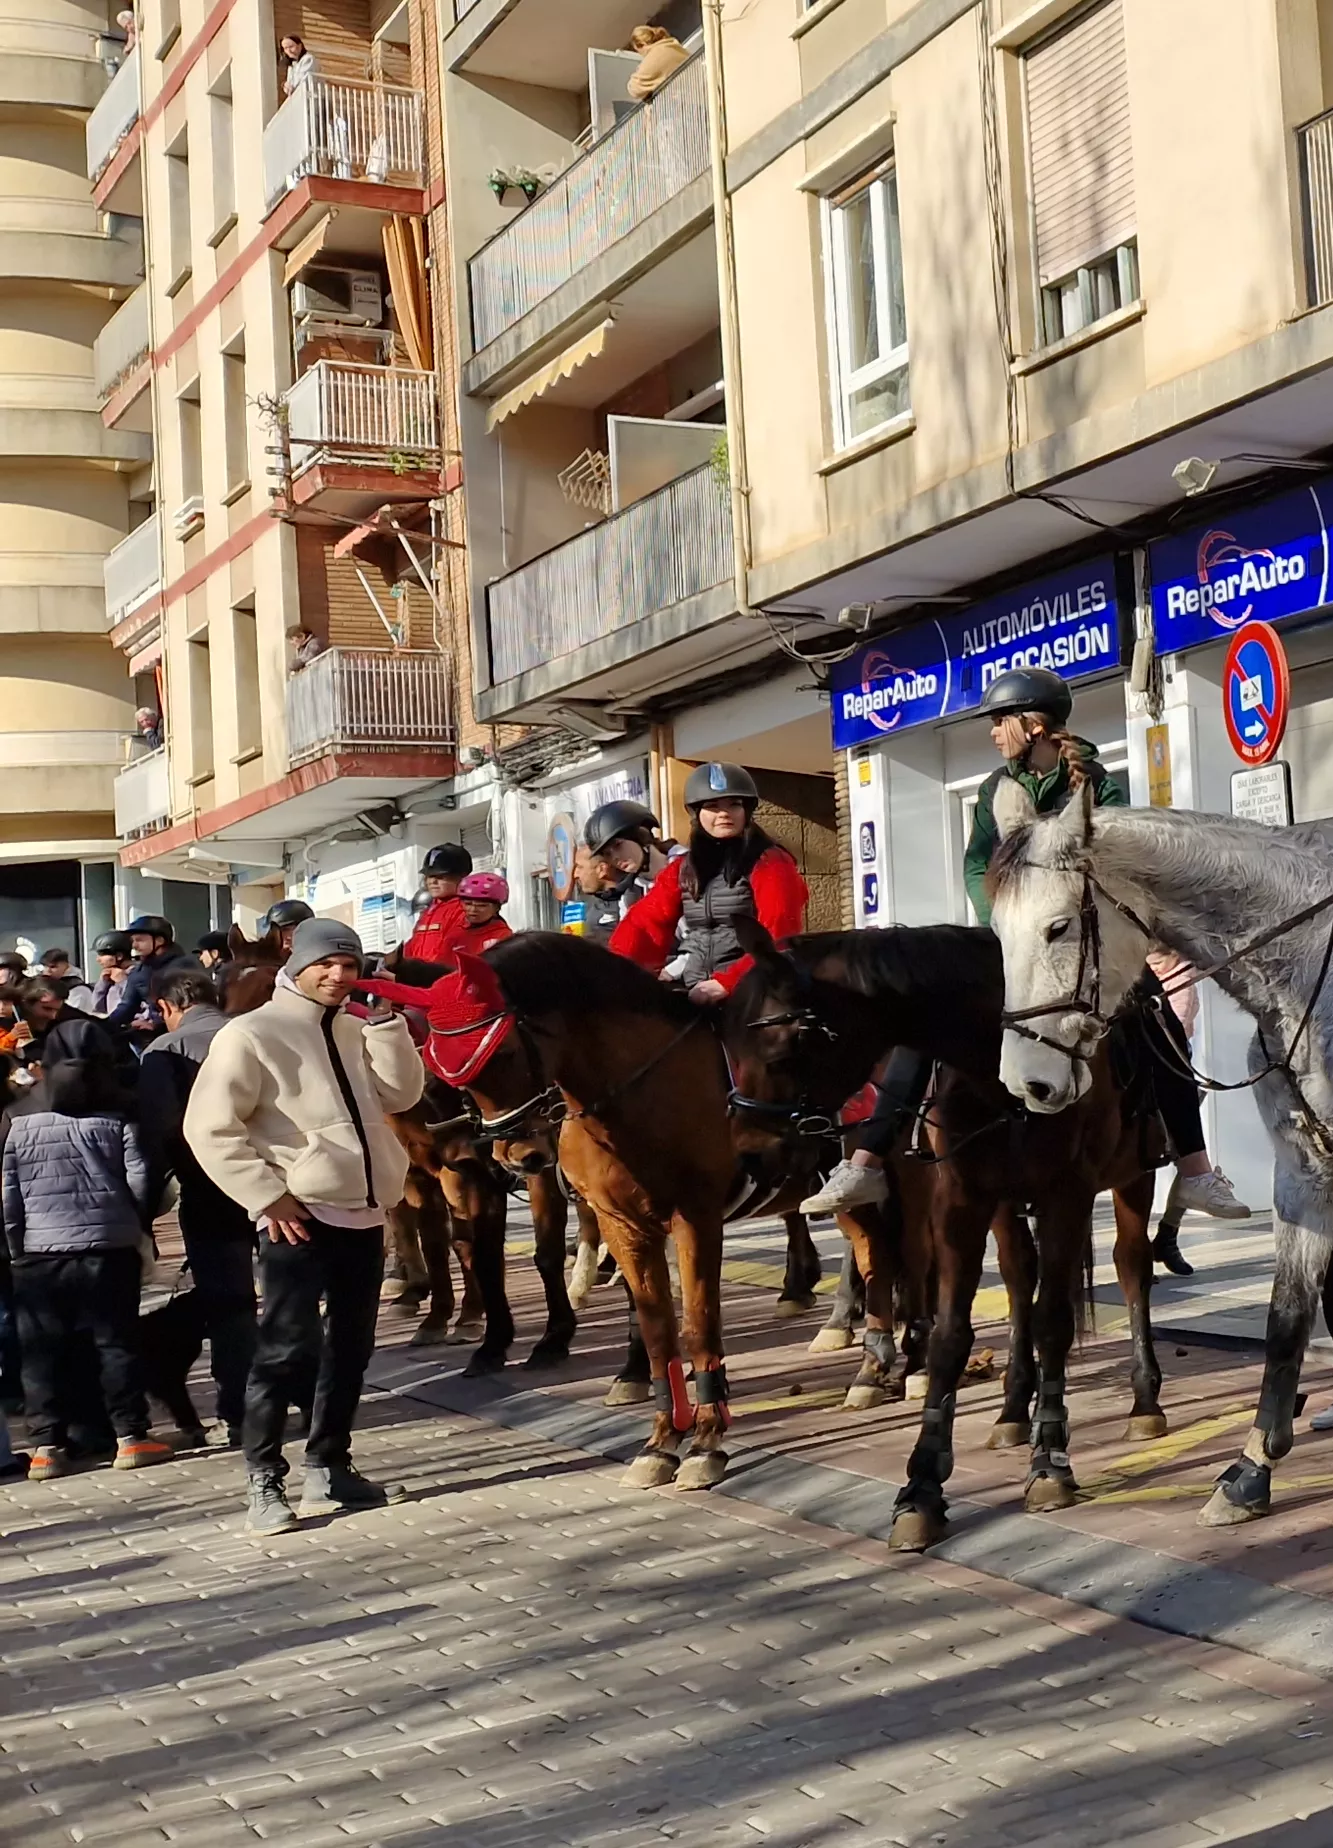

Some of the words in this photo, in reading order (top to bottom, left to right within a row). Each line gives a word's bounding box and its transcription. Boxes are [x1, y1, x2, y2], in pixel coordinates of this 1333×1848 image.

[1167, 552, 1305, 619] ReparAuto
[961, 581, 1106, 658] AUTOMÓVILES
[842, 673, 938, 723] ReparAuto
